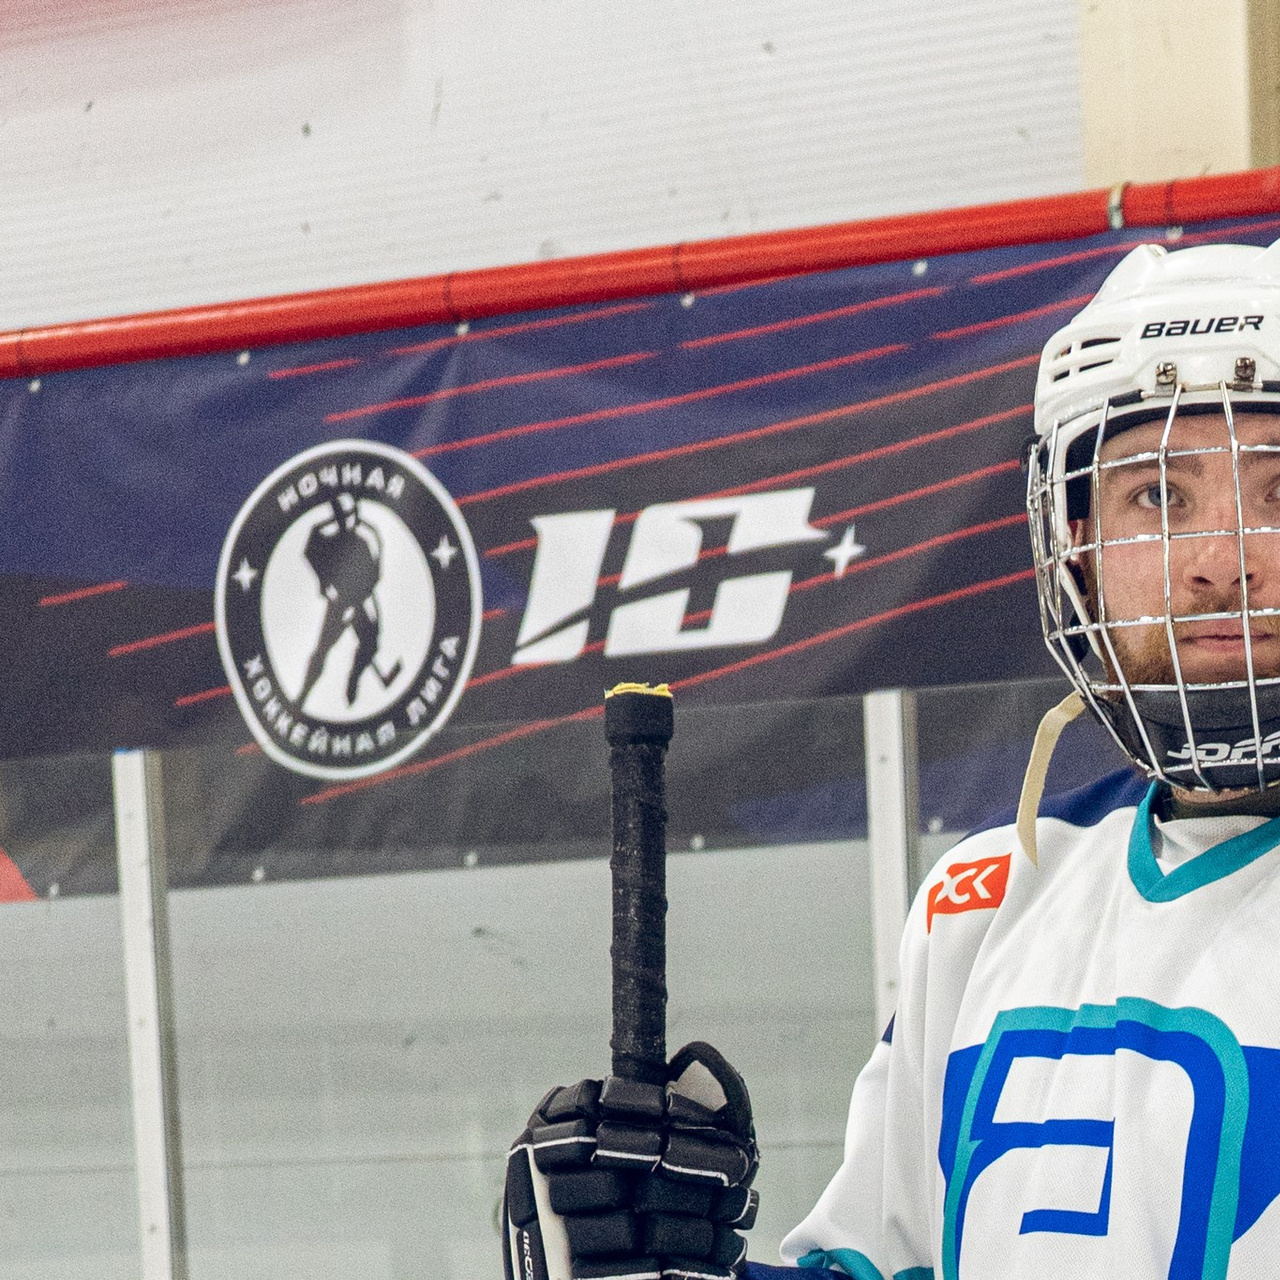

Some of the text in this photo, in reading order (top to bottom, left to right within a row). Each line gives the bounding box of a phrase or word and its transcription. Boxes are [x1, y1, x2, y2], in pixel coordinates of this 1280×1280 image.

[1140, 315, 1265, 340] BAUER
[277, 464, 405, 512] НОЧНАЯ
[243, 636, 460, 756] ХОККЕЙНАЯ ЛИГА
